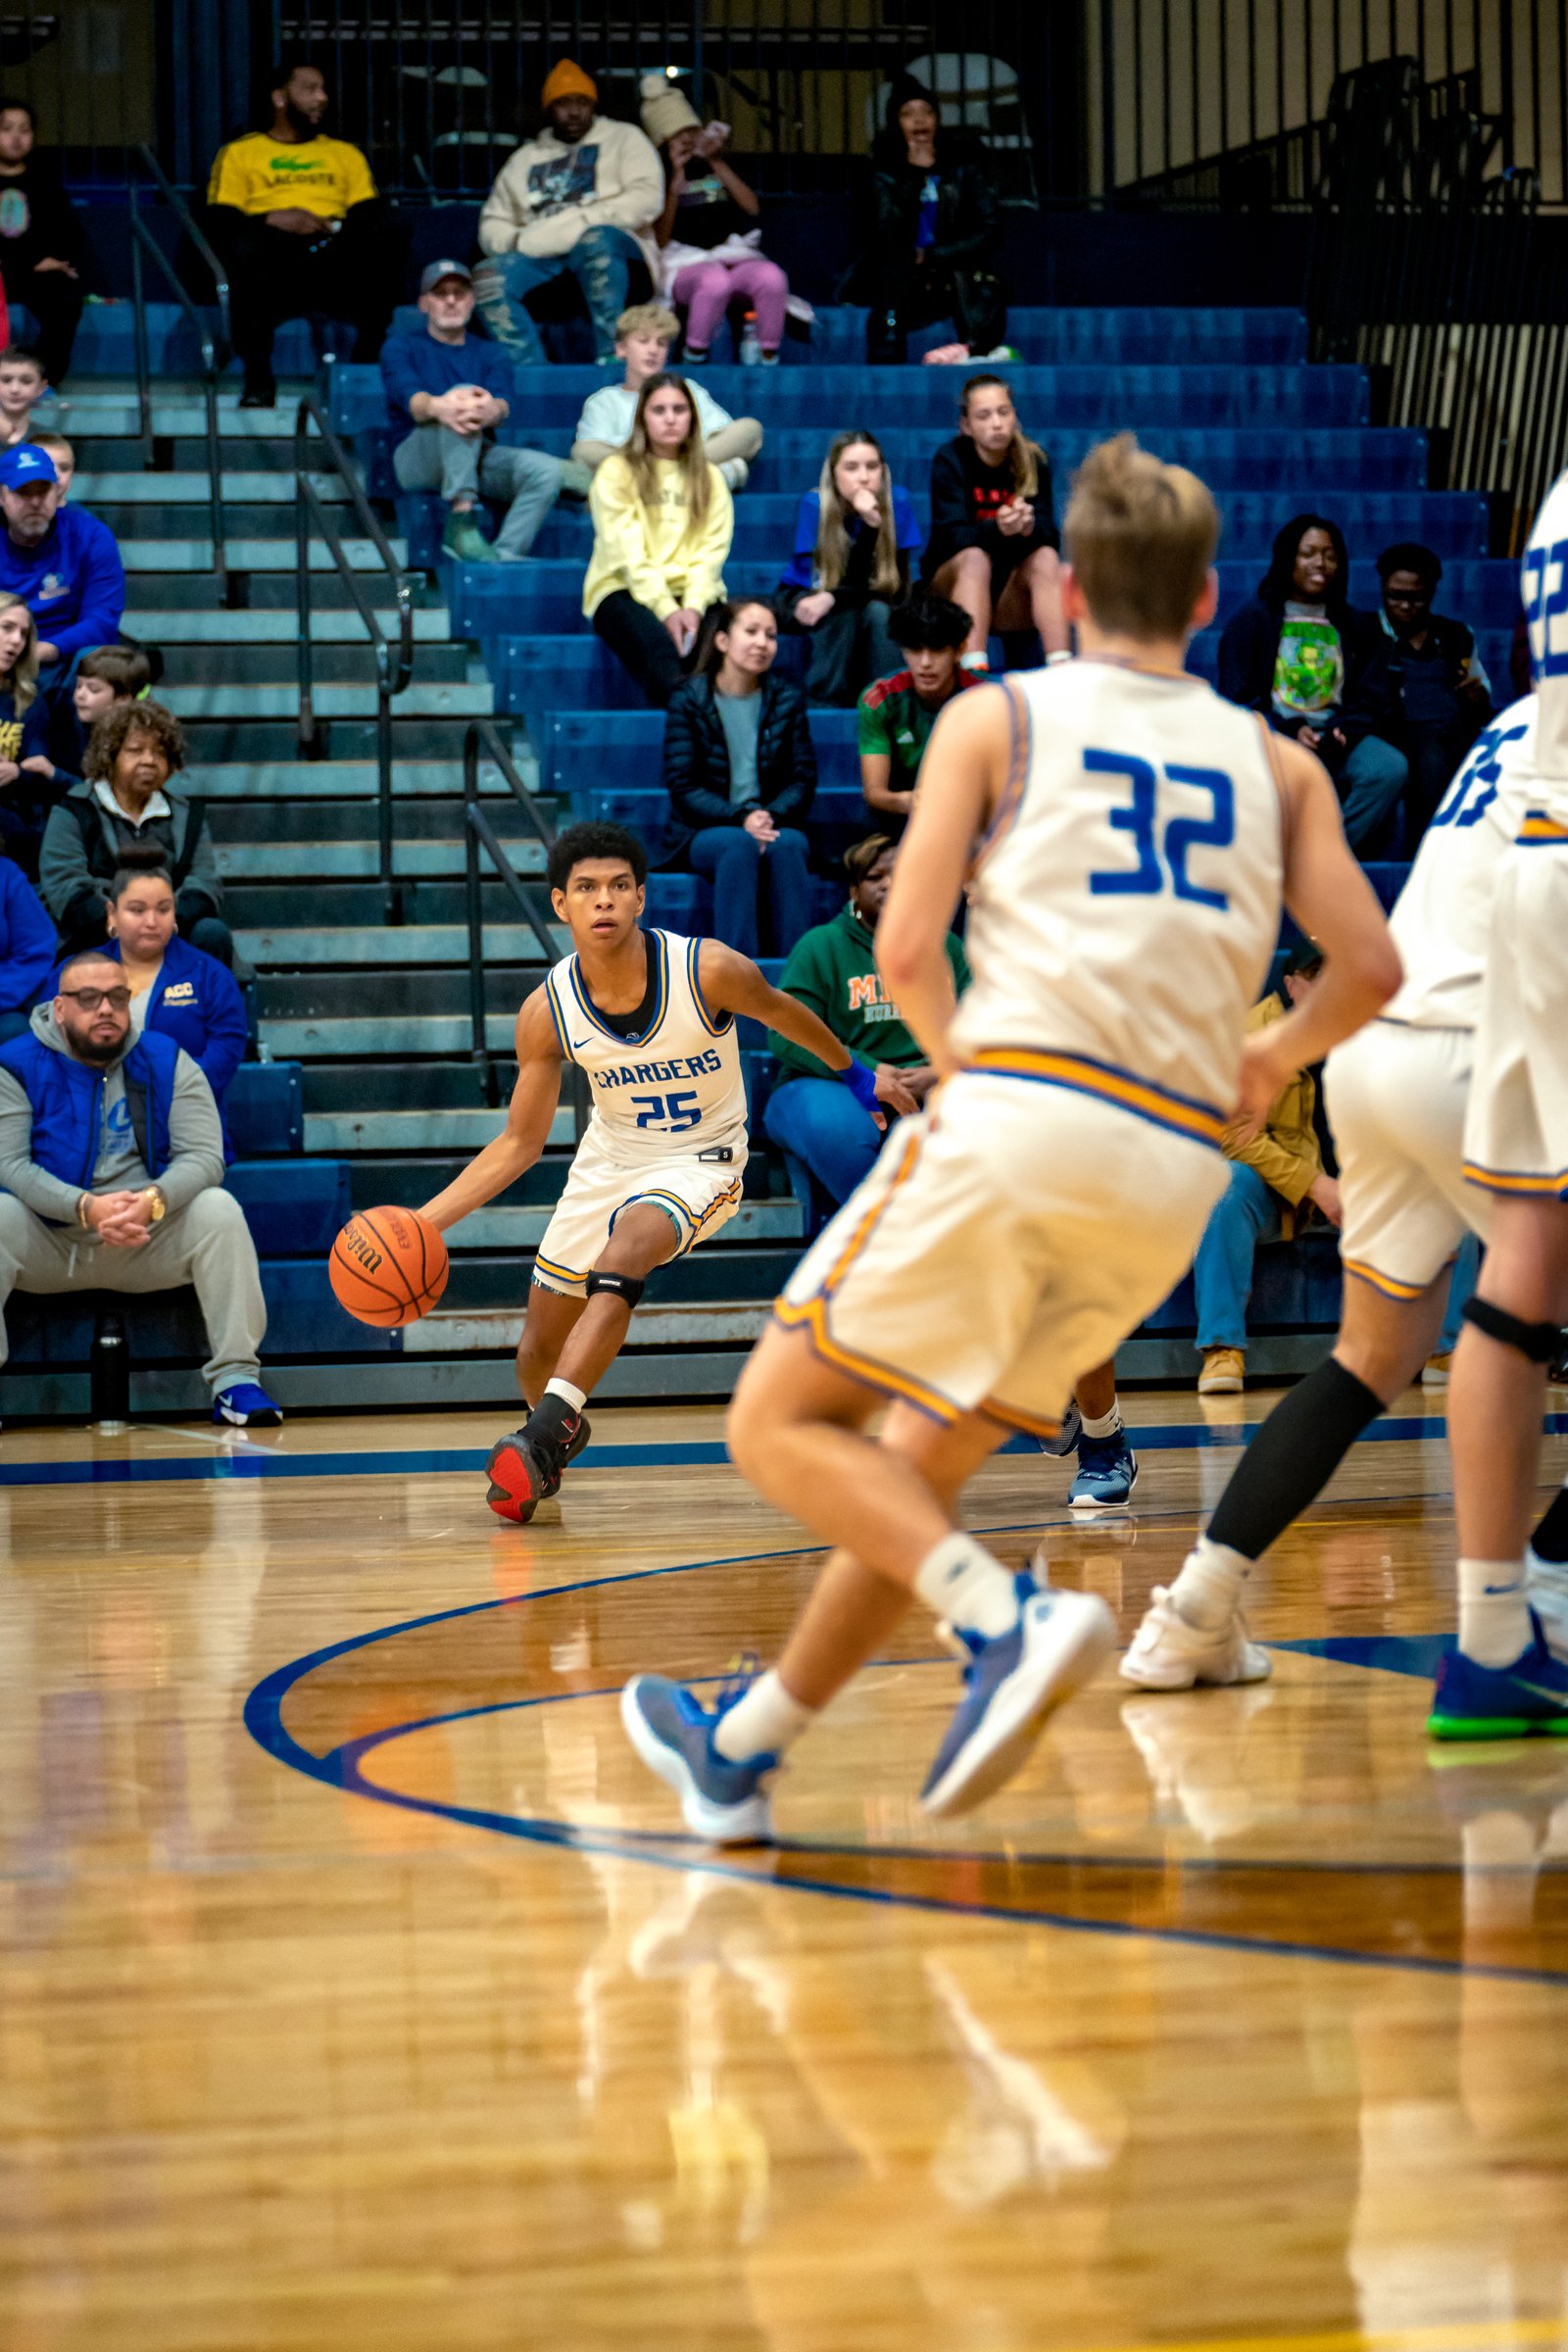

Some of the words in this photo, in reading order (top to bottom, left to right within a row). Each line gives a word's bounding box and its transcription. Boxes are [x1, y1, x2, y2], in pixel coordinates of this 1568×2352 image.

[1083, 749, 1235, 912] 32
[164, 982, 194, 999] ACC
[594, 1049, 723, 1089] CHARGERS
[630, 1090, 702, 1133] 25
[722, 1151, 729, 1159] S
[343, 1222, 383, 1276] Wilso
